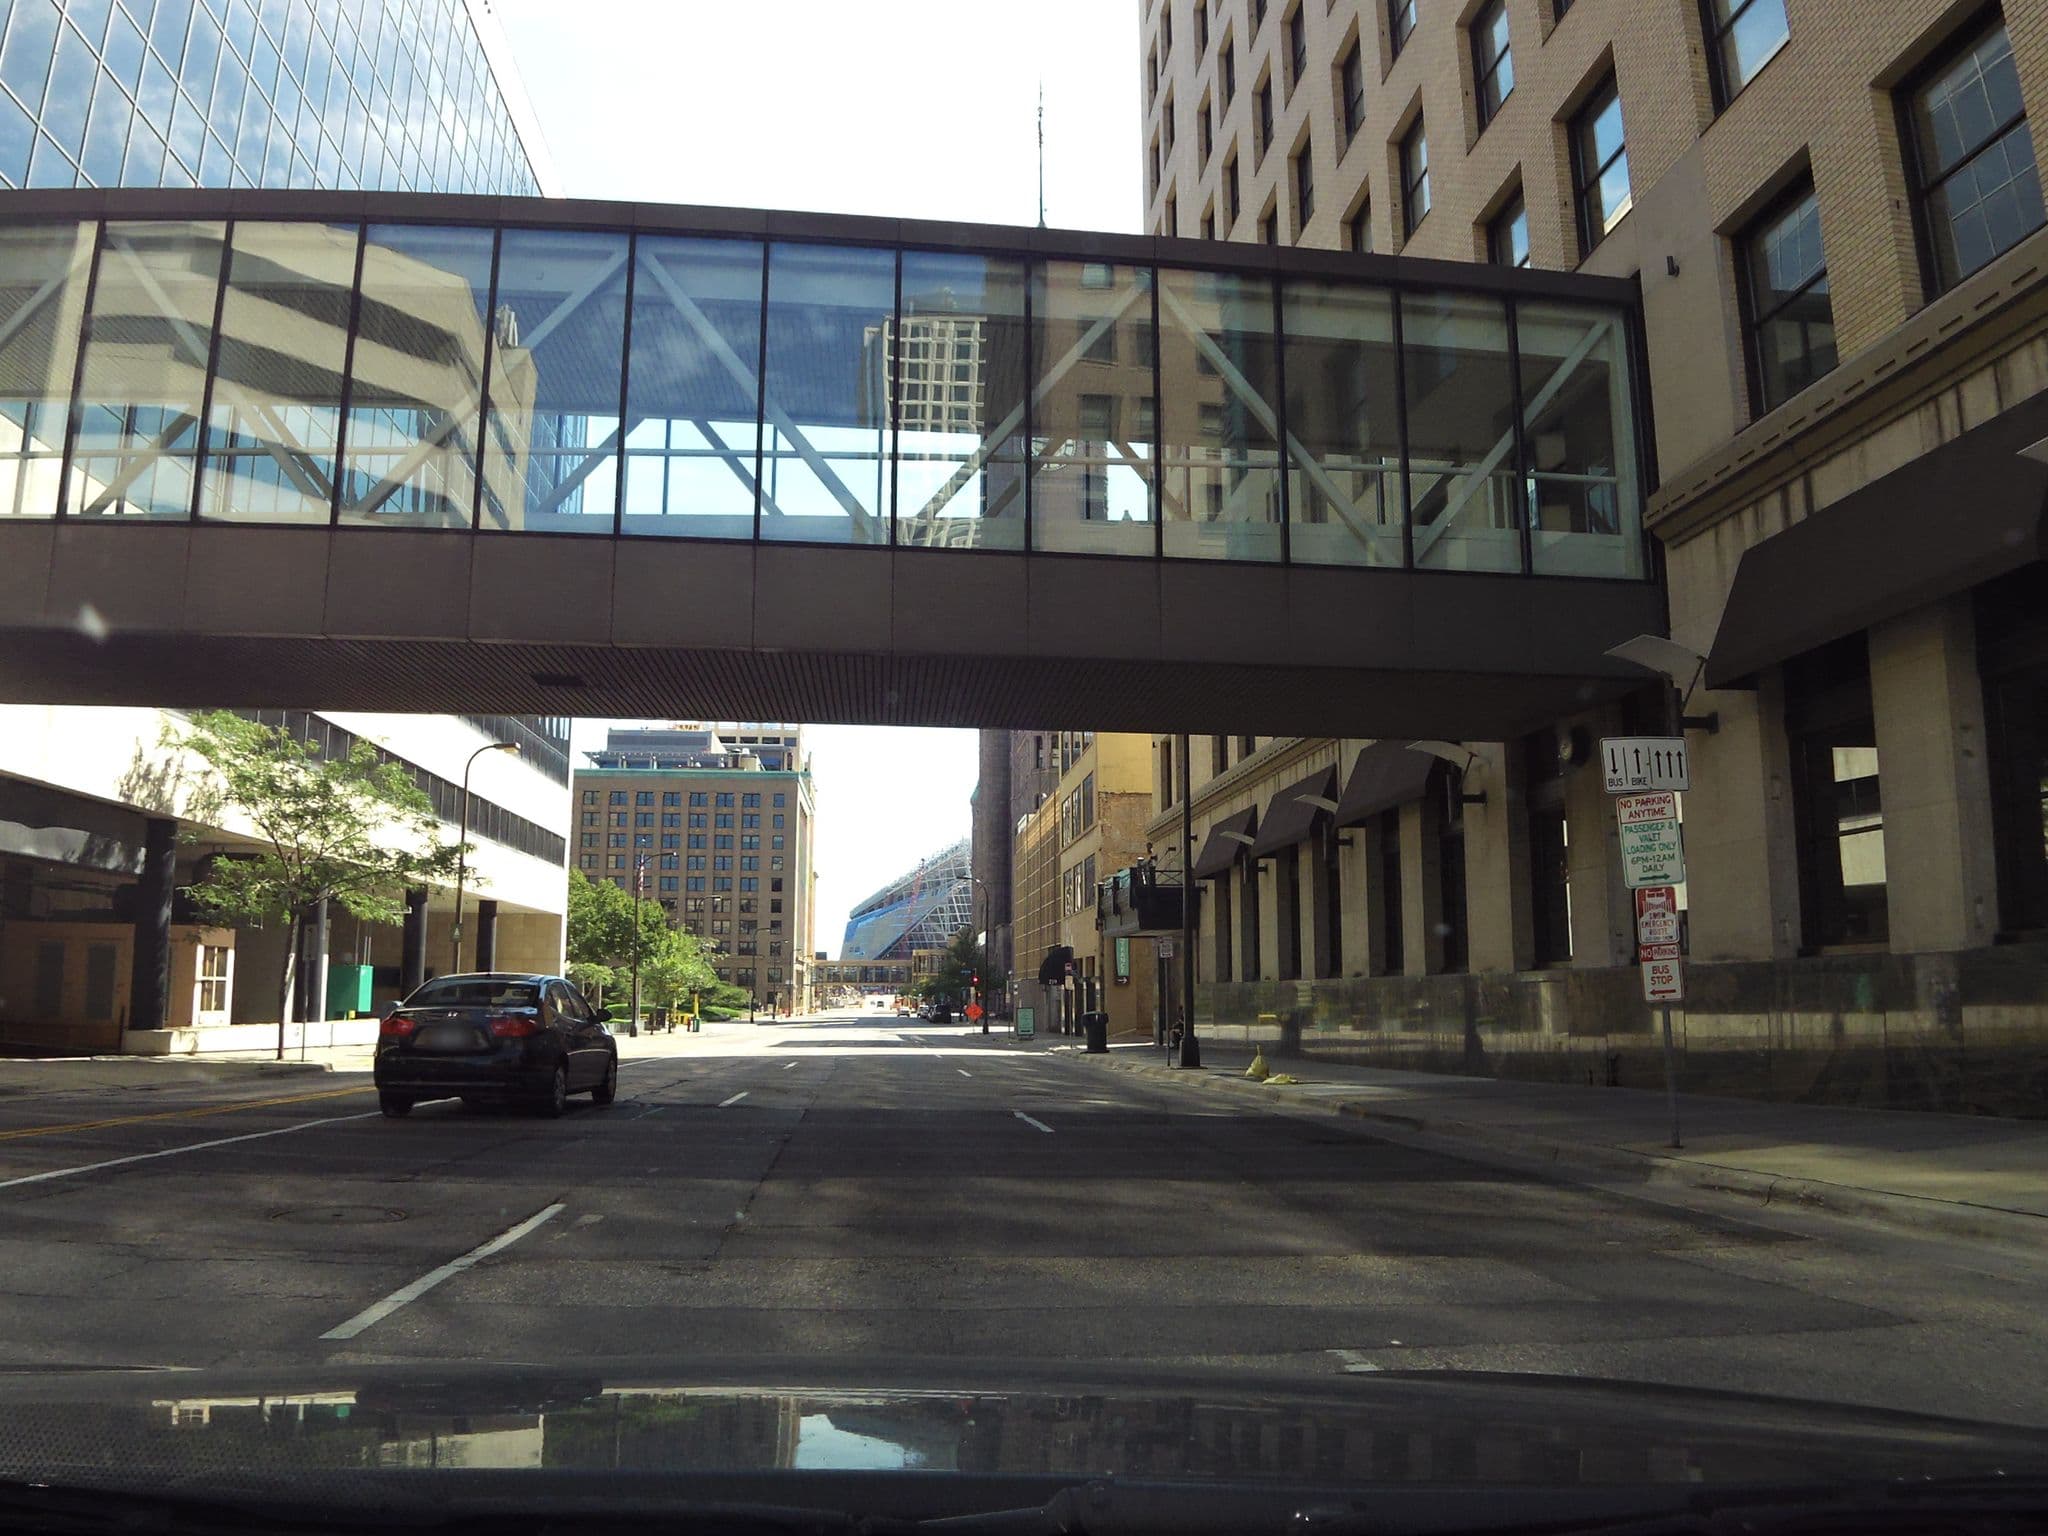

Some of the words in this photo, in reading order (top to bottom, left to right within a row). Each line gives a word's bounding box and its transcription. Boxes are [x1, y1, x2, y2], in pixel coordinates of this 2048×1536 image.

[1608, 778, 1623, 787] BUS
[1632, 777, 1648, 786] BIKE
[1621, 799, 1632, 809] NO
[1635, 795, 1671, 807] PARKING
[1628, 807, 1666, 819] ANYTIME
[1624, 822, 1664, 833] PASSENGER
[1639, 832, 1660, 842] VALET
[1626, 843, 1656, 854] LOADING
[1658, 841, 1676, 851] ONLY
[1642, 864, 1664, 873] DAILY
[1641, 949, 1652, 958] NO
[1652, 965, 1669, 974] BUS
[1651, 976, 1673, 985] STOP
